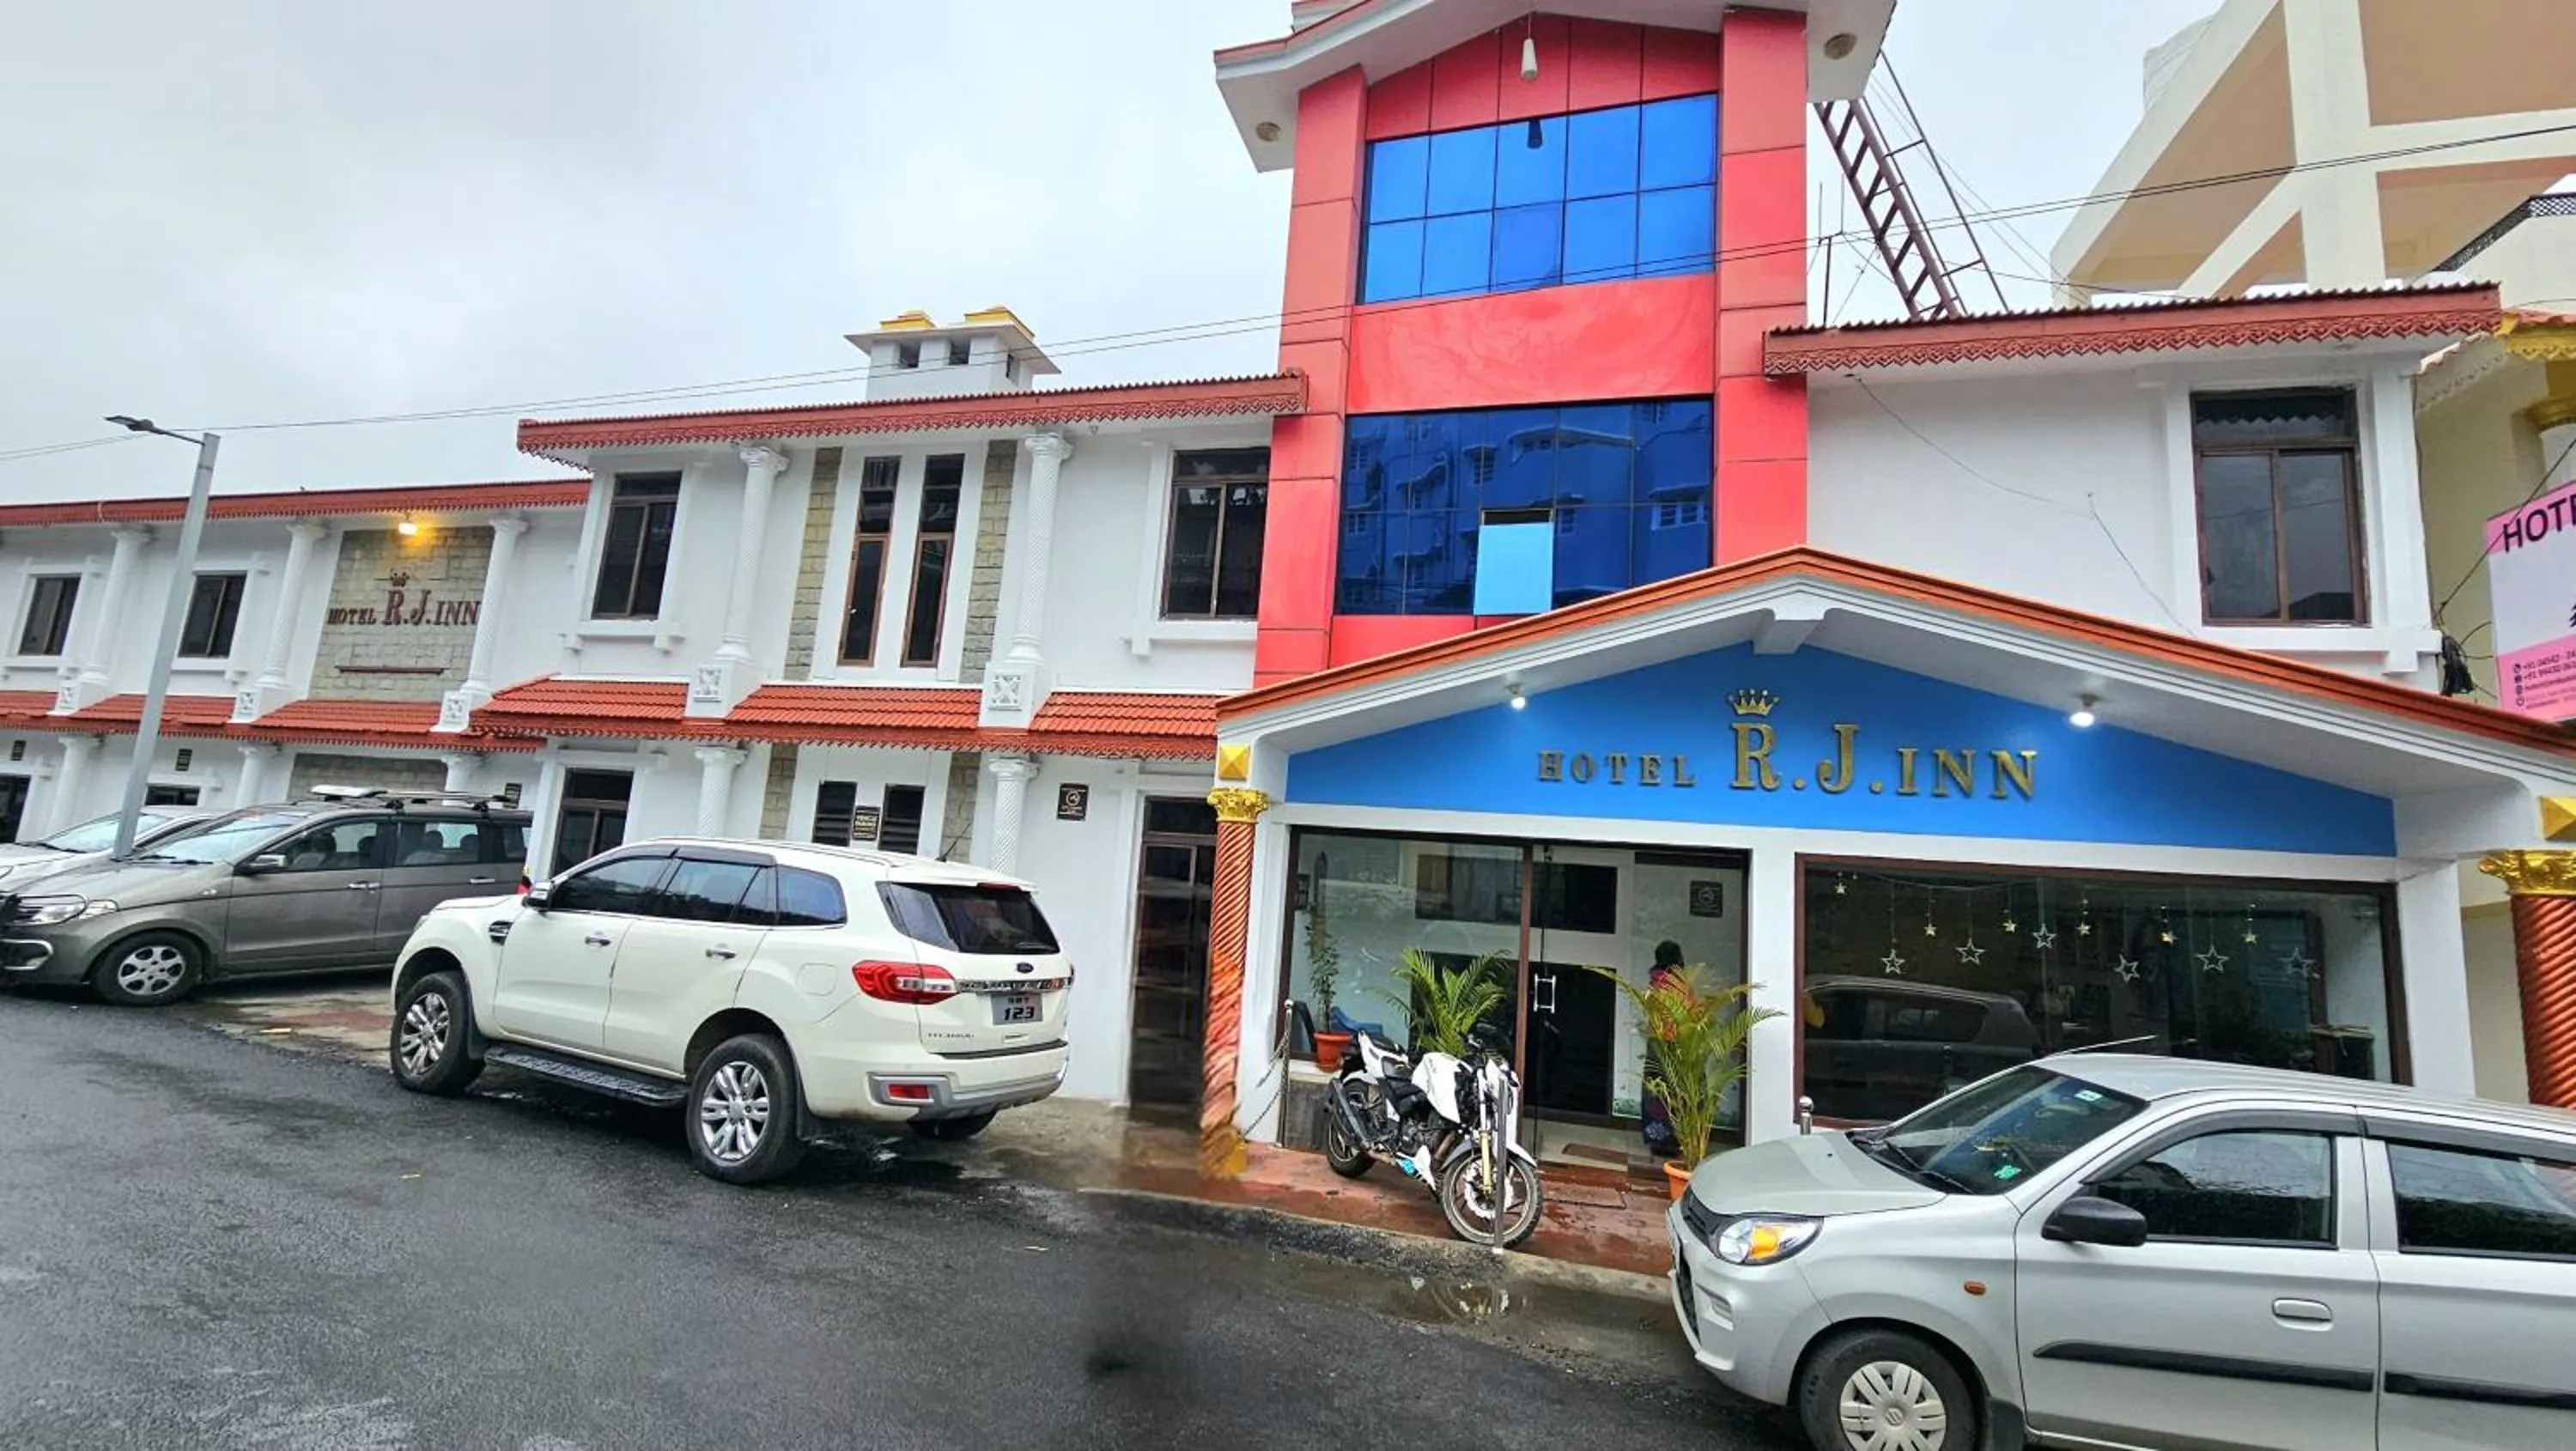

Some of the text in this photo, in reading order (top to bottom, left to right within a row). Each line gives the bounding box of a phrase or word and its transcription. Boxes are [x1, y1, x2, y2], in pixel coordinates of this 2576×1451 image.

[327, 607, 377, 625] HOTEL
[1538, 750, 1696, 787] HOTEL
[1005, 1006, 1035, 1020] 123
